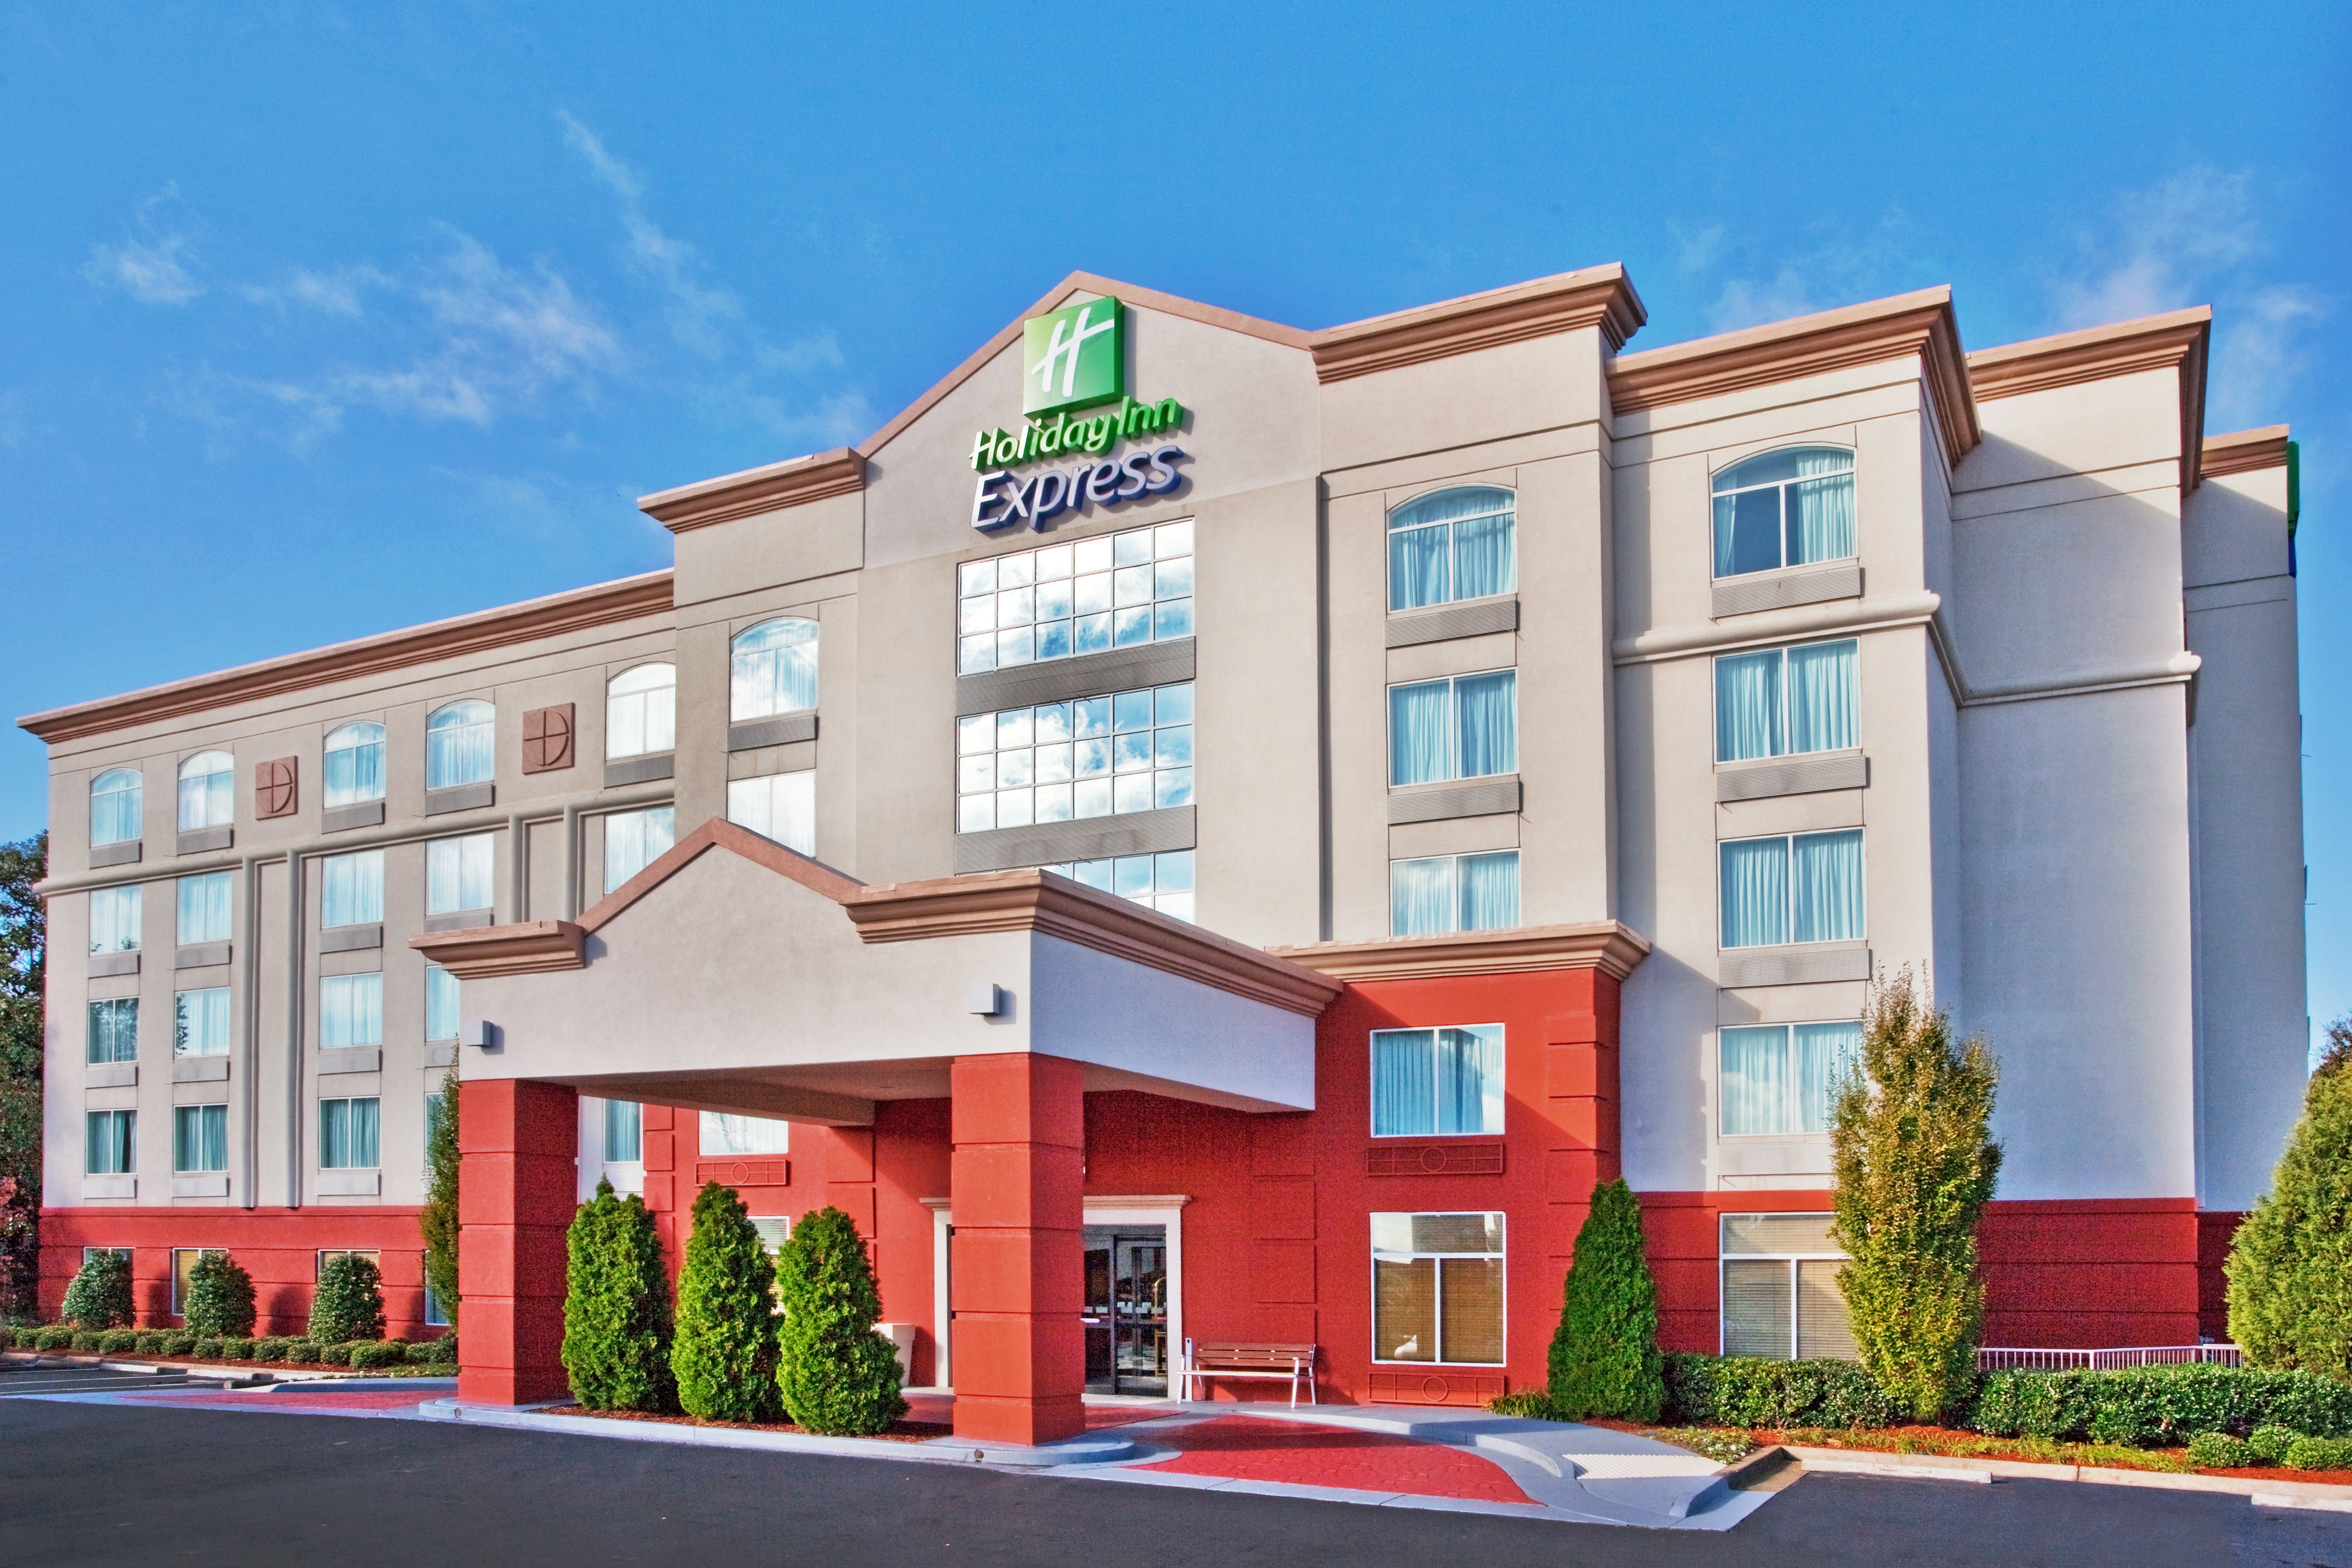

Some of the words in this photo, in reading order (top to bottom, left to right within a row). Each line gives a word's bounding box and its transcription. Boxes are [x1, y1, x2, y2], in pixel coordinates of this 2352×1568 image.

[1031, 307, 1115, 397] H
[968, 412, 1114, 470] Holiday
[1117, 395, 1179, 436] Inn
[969, 445, 1179, 529] Express
